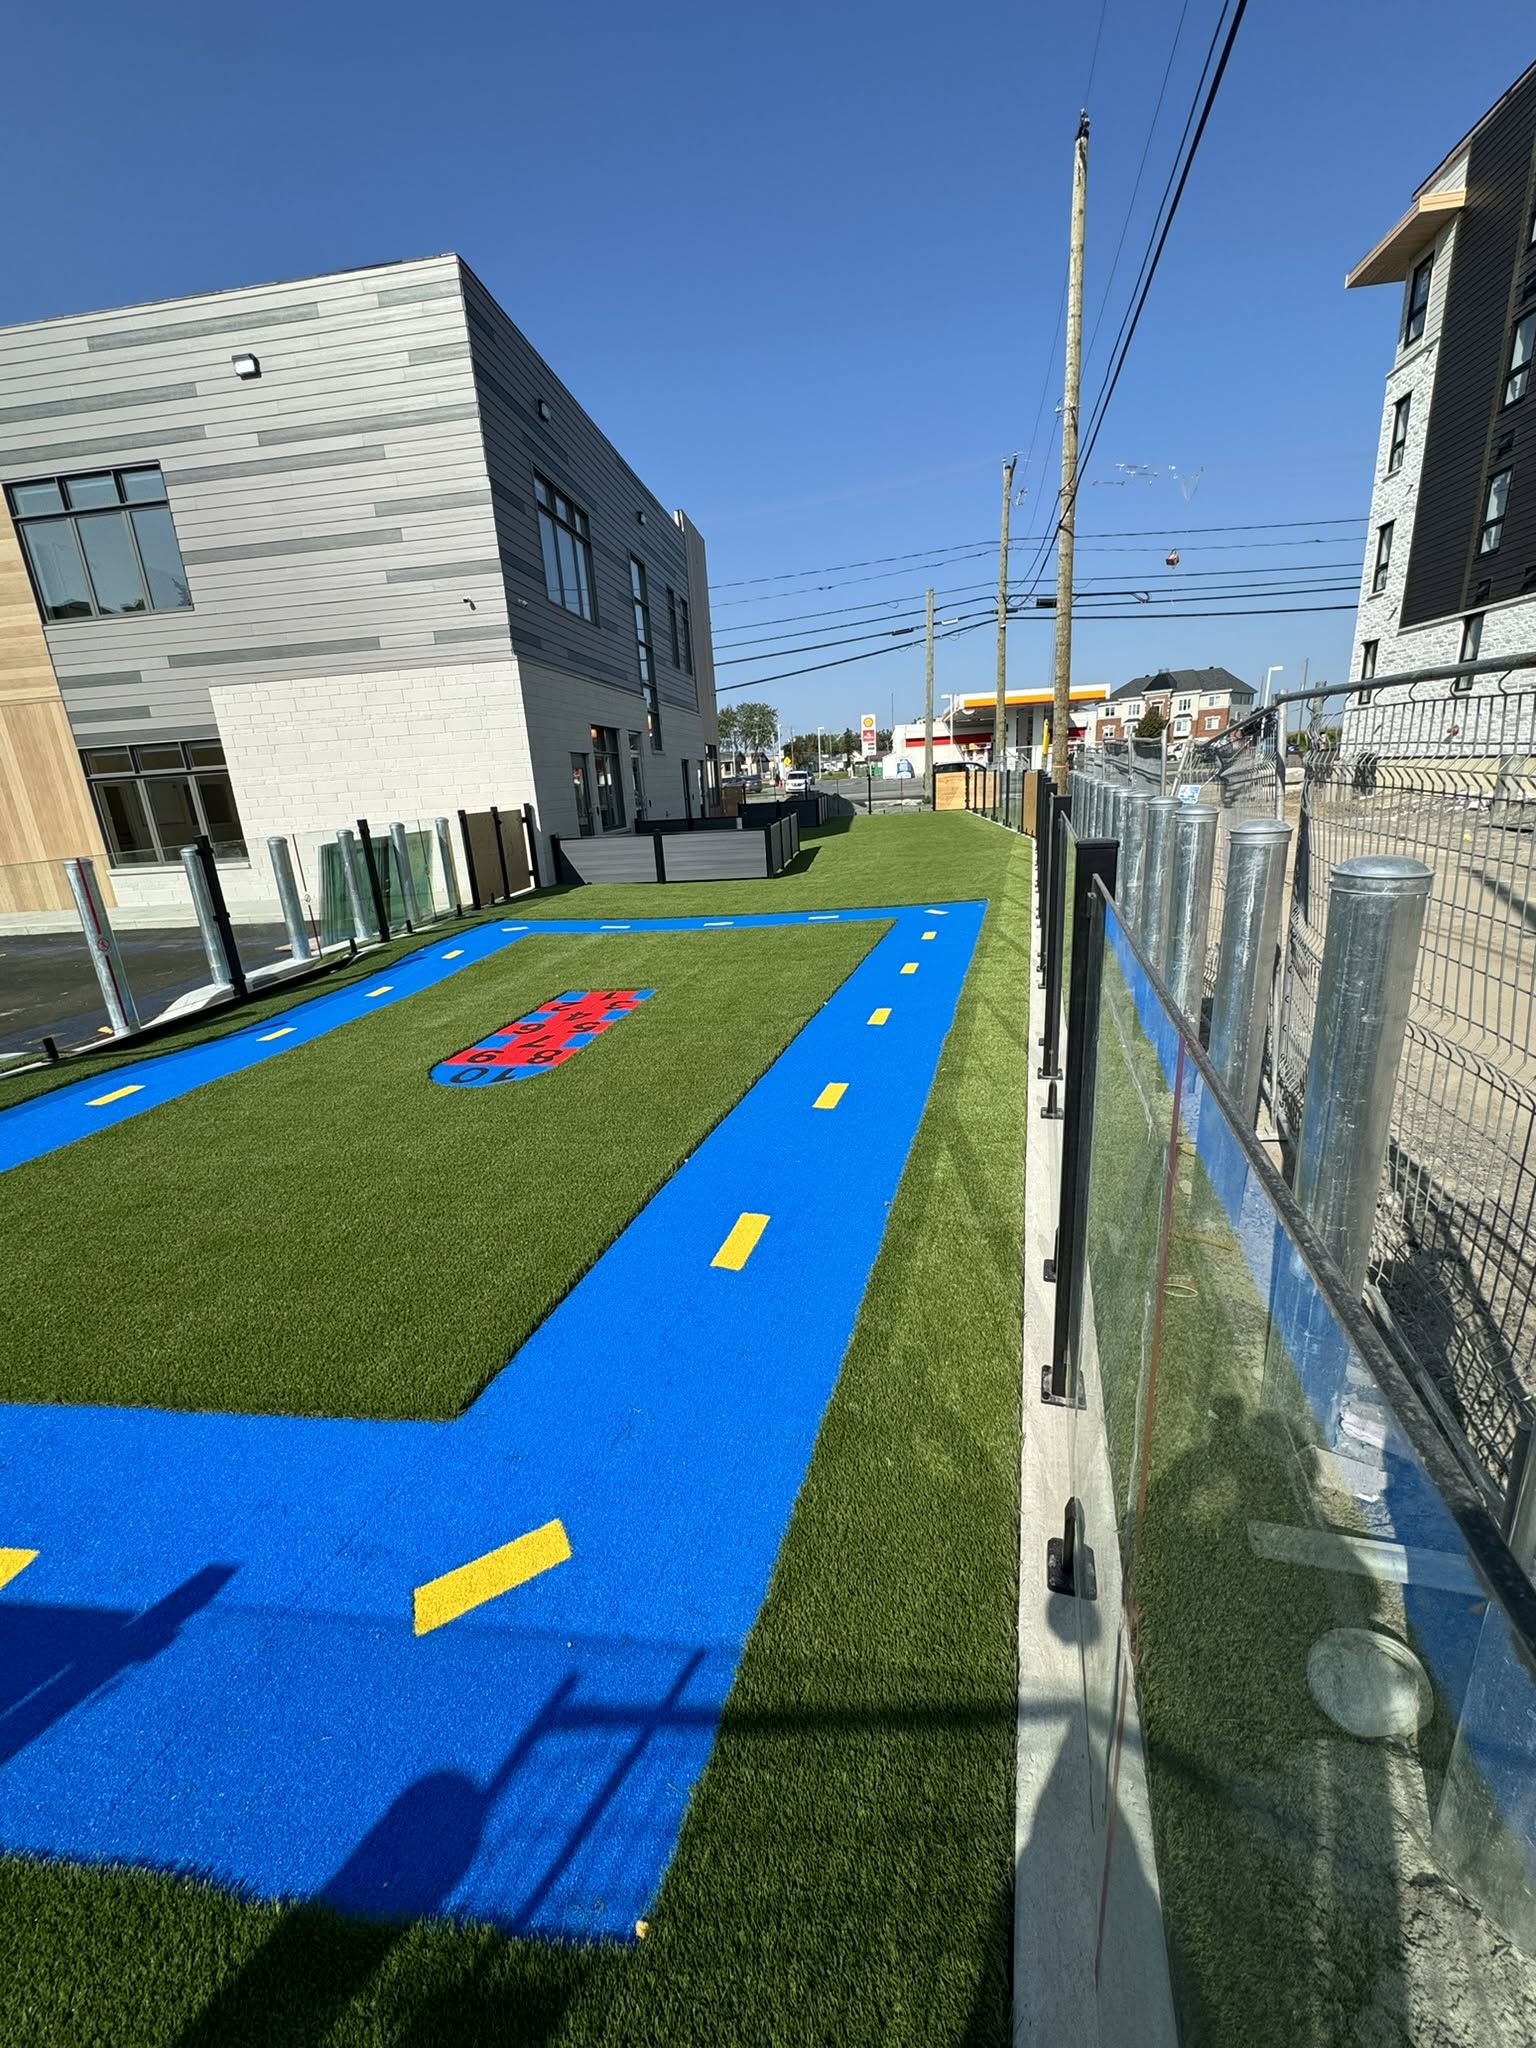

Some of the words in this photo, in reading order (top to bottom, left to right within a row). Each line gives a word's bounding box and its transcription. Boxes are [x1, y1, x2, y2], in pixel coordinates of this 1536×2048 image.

[600, 992, 617, 1001] 1
[551, 1002, 582, 1011] 2
[605, 1000, 633, 1010] 3
[563, 1011, 593, 1021] 4
[512, 1023, 546, 1035] 6
[567, 1022, 601, 1033] 5
[518, 1035, 556, 1048] 7
[467, 1050, 505, 1064] 9
[527, 1049, 563, 1064] 8
[449, 1067, 517, 1084] 10
